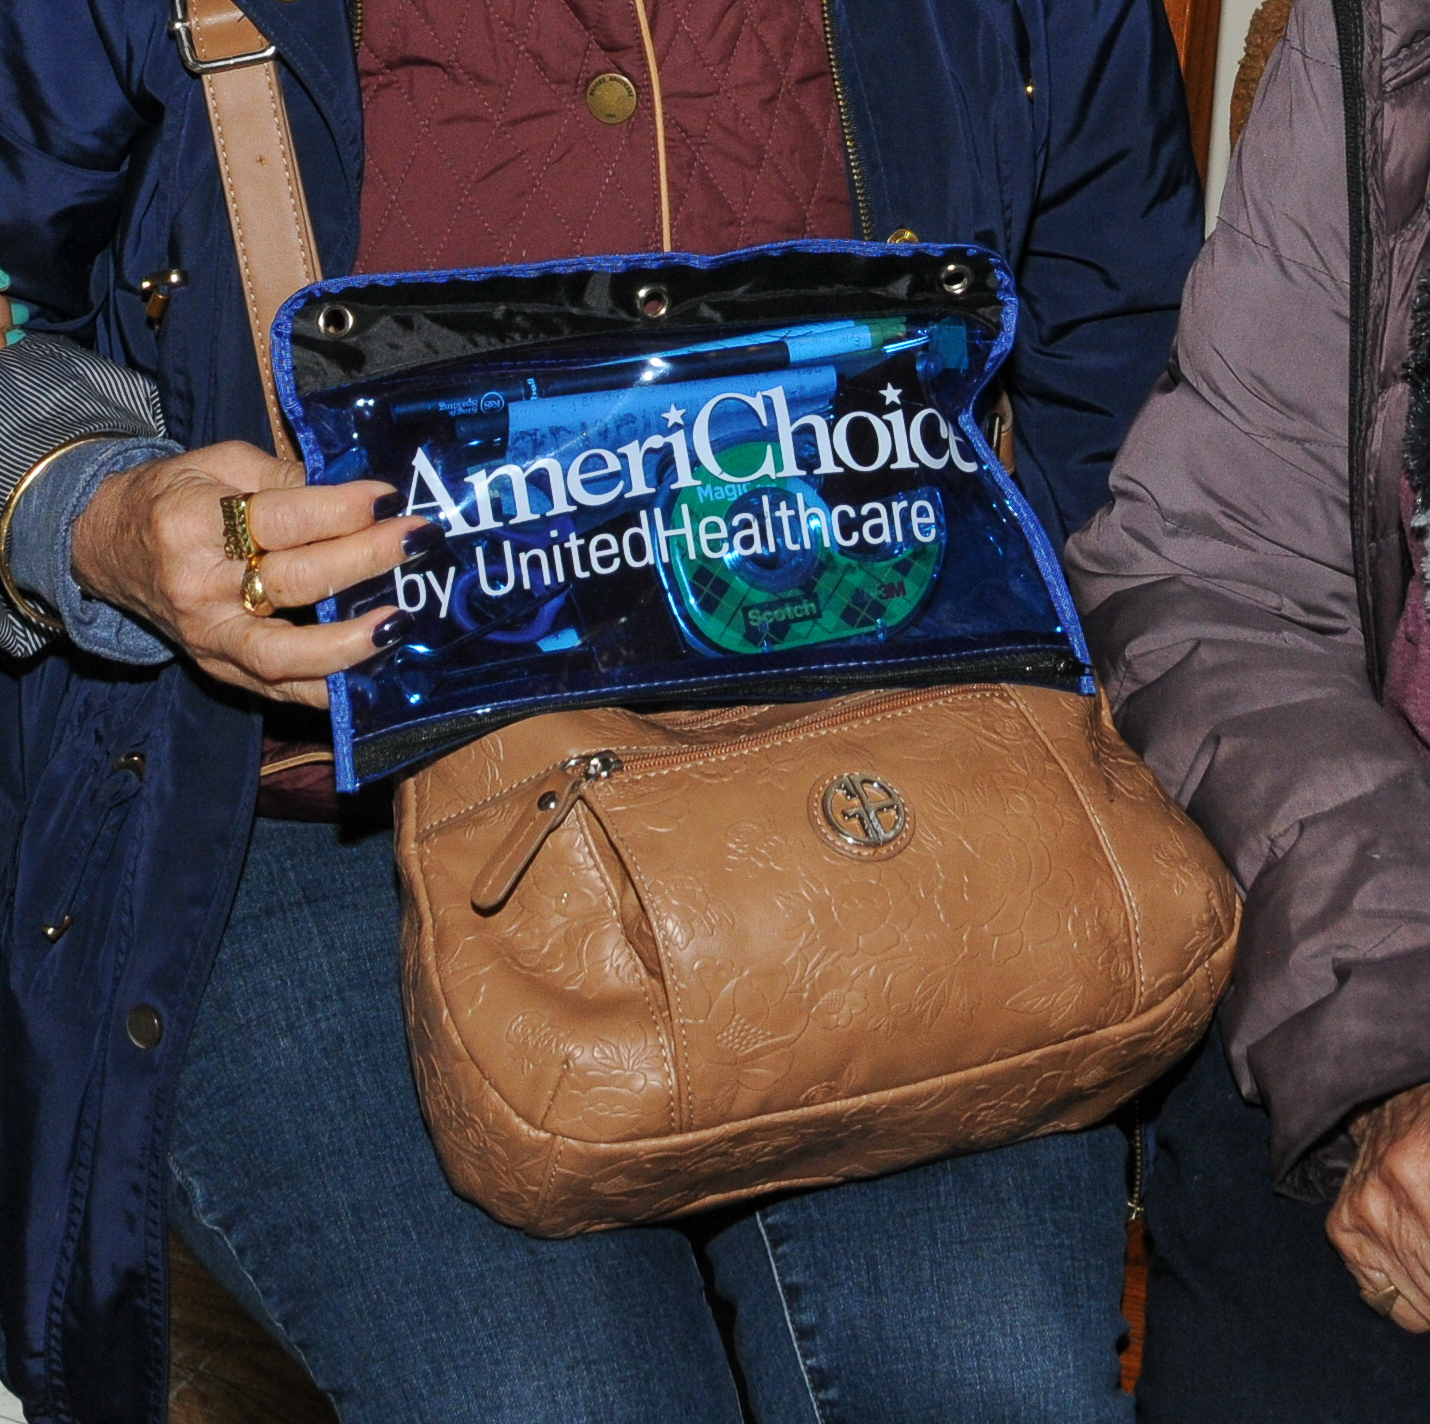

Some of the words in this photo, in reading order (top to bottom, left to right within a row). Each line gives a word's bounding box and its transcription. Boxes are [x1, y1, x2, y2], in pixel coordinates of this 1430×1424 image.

[696, 483, 751, 503] Magic
[394, 565, 455, 618] by
[476, 492, 936, 596] UnitedHealthcare
[876, 580, 907, 600] 3M
[747, 599, 818, 626] Scotch
